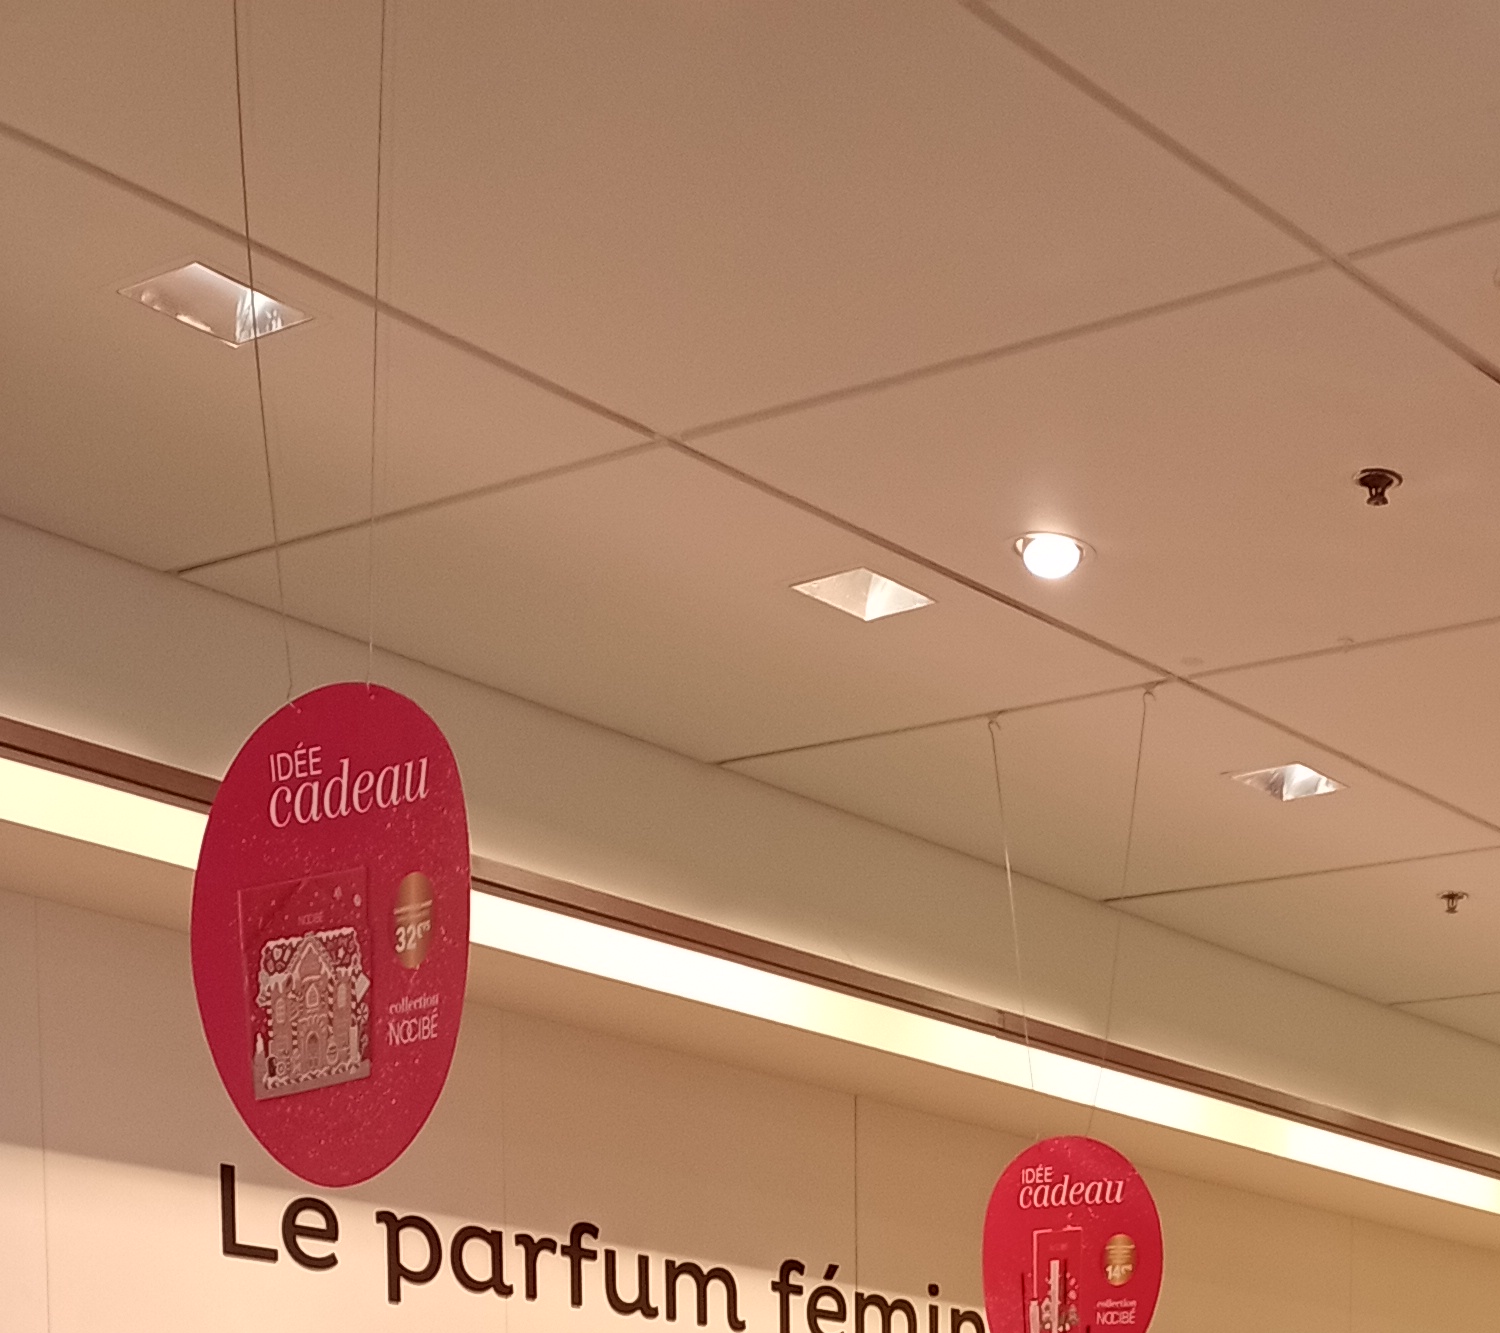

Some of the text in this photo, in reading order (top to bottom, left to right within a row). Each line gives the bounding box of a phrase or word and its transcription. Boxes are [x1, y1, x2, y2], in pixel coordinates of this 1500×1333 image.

[269, 742, 322, 783] IDÉE
[269, 756, 429, 828] cadeau
[388, 1008, 439, 1046] NOCIBÉ
[1019, 1174, 1124, 1209] cadeau
[1021, 1163, 1053, 1185] IDÉE
[219, 1163, 339, 1271] Le
[375, 1207, 747, 1331] parfum
